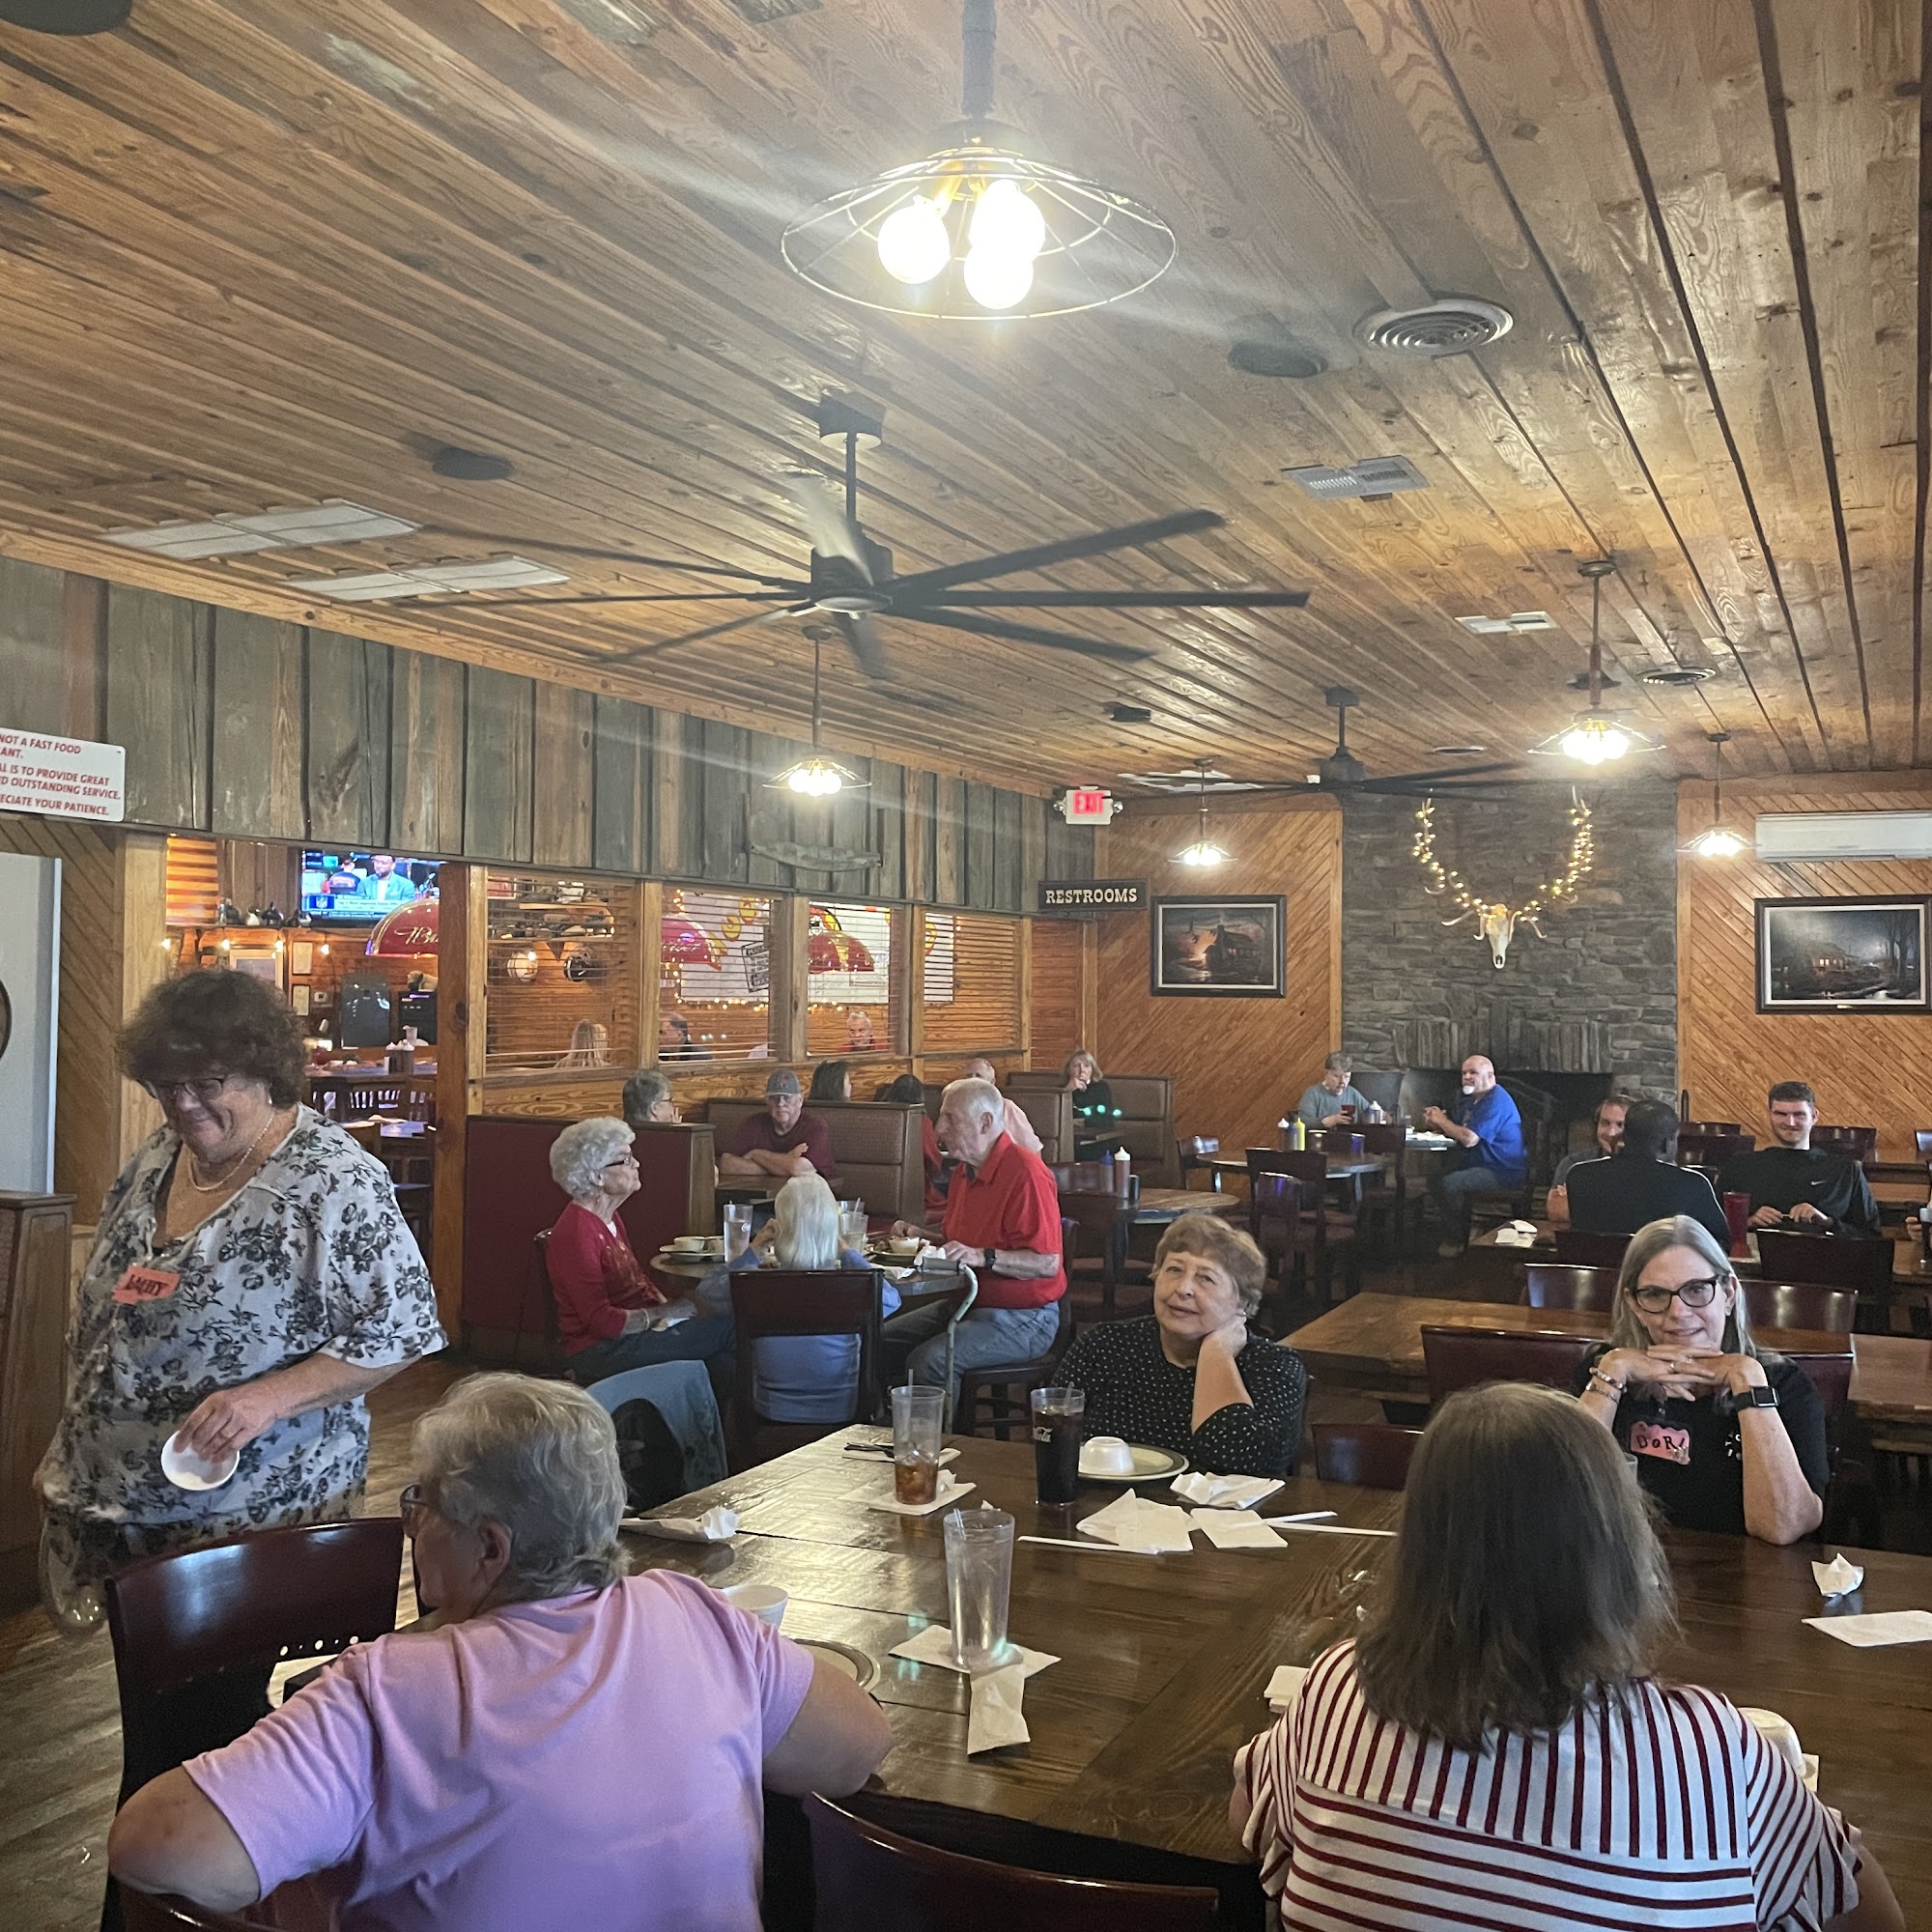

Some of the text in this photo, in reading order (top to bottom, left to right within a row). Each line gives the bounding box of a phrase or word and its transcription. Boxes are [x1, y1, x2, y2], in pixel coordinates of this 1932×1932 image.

[20, 737, 27, 746] A
[30, 738, 52, 751] FAST
[54, 742, 81, 754] FOOD
[11, 764, 18, 774] IS
[21, 766, 34, 776] TO
[37, 769, 78, 782] PROVIDE
[80, 774, 110, 786] GREAT
[11, 778, 80, 795] OUTSTANDING
[82, 786, 121, 800] SERVICE.
[35, 798, 63, 810] YOUR
[64, 802, 109, 815] PATIENCE.
[1073, 793, 1105, 814] EXIT
[1045, 888, 1138, 904] RESTROOMS
